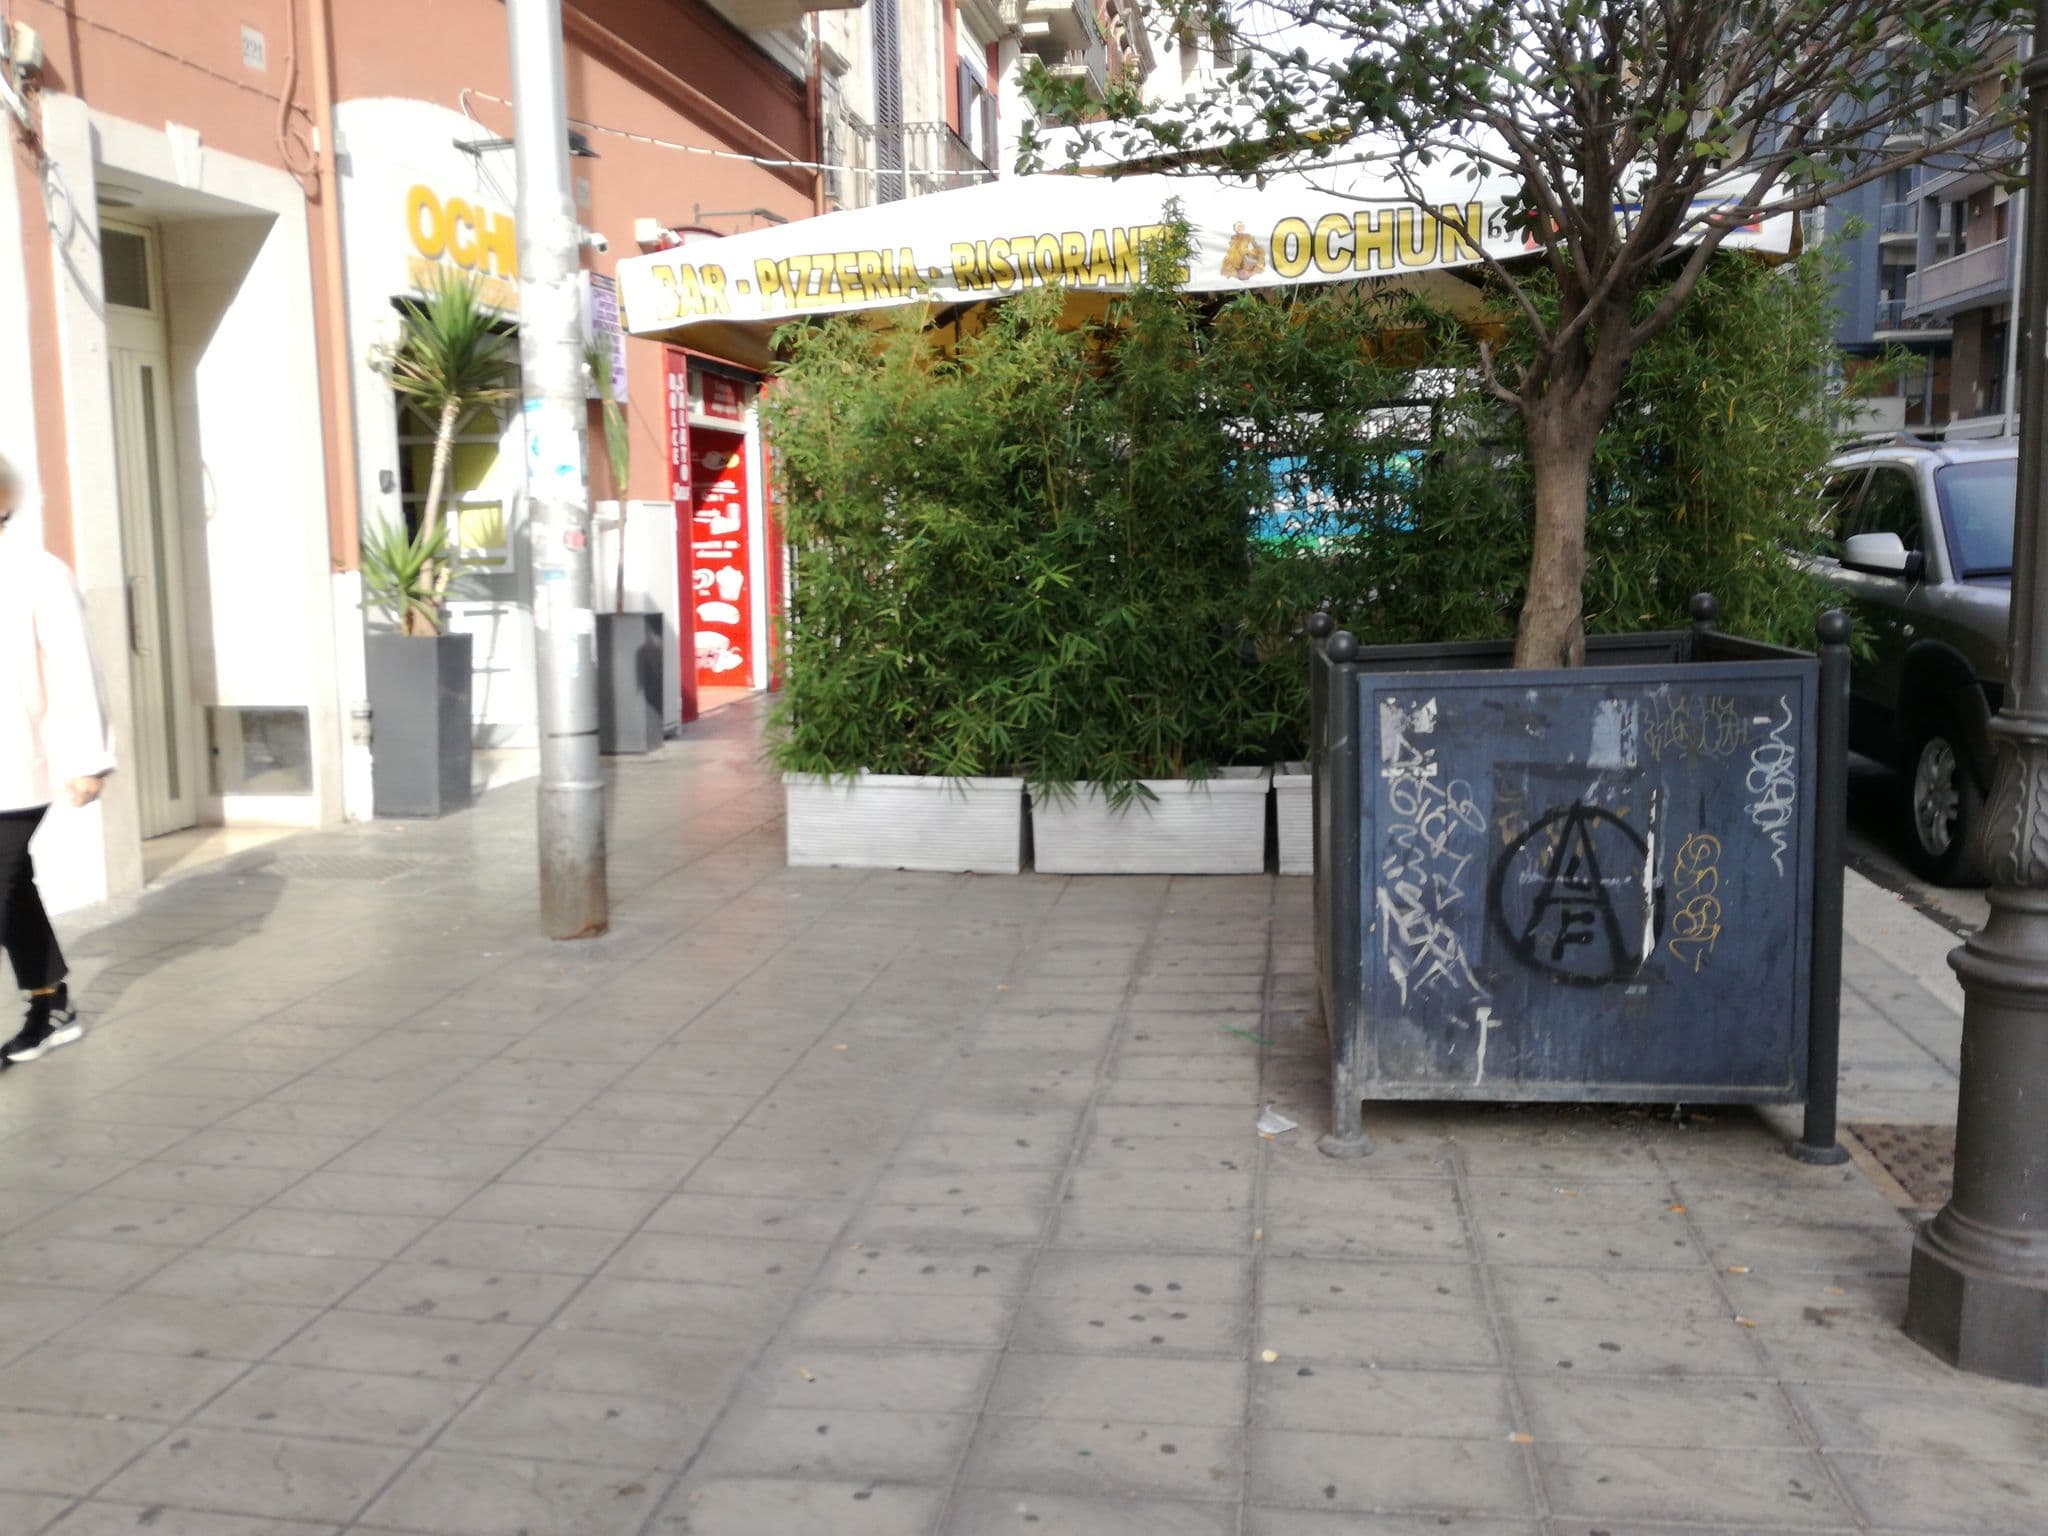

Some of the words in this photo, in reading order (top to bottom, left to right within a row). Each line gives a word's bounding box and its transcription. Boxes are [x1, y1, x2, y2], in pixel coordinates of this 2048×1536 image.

[651, 263, 731, 321] BAR
[753, 246, 922, 312] PIZZERIA
[1269, 201, 1483, 279] OCHUN
